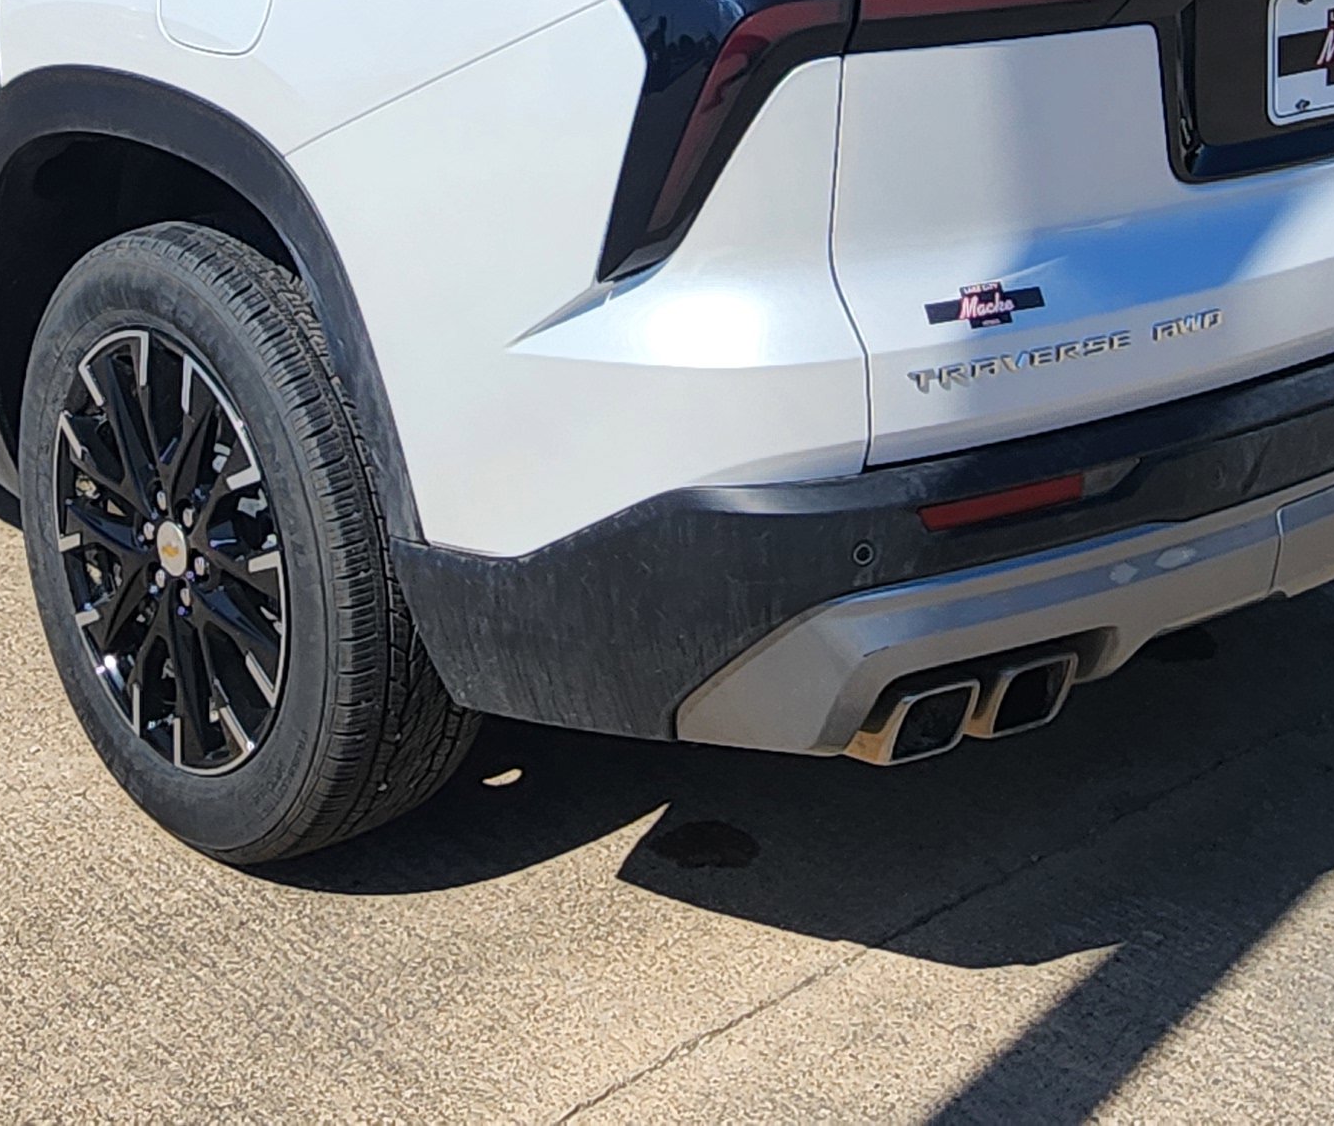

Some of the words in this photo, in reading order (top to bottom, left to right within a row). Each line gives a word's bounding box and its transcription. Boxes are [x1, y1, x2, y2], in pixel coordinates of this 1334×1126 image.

[959, 291, 1015, 320] Macke
[907, 329, 1133, 392] TRAVERSE
[1152, 308, 1224, 341] AWD
